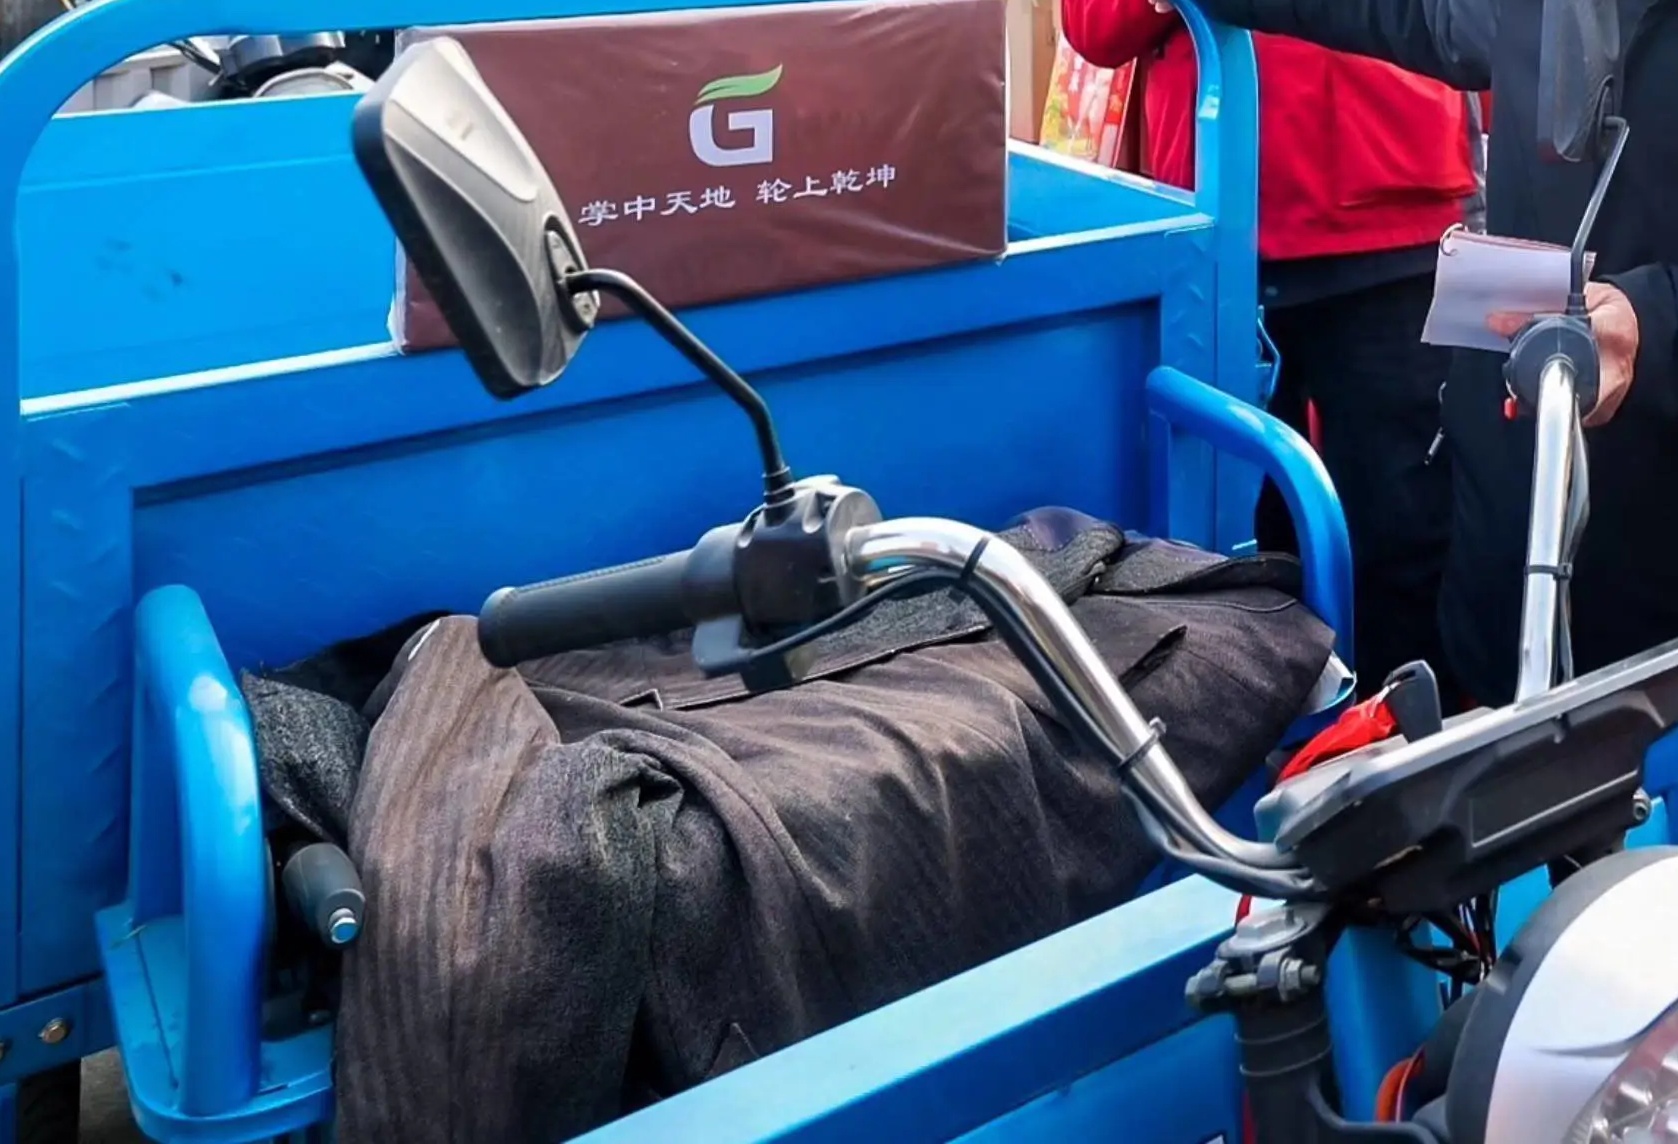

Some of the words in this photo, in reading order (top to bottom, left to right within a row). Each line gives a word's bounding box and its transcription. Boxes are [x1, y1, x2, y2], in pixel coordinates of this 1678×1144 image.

[578, 186, 736, 227] 掌中天地
[756, 164, 896, 203] 轮上乾坤
